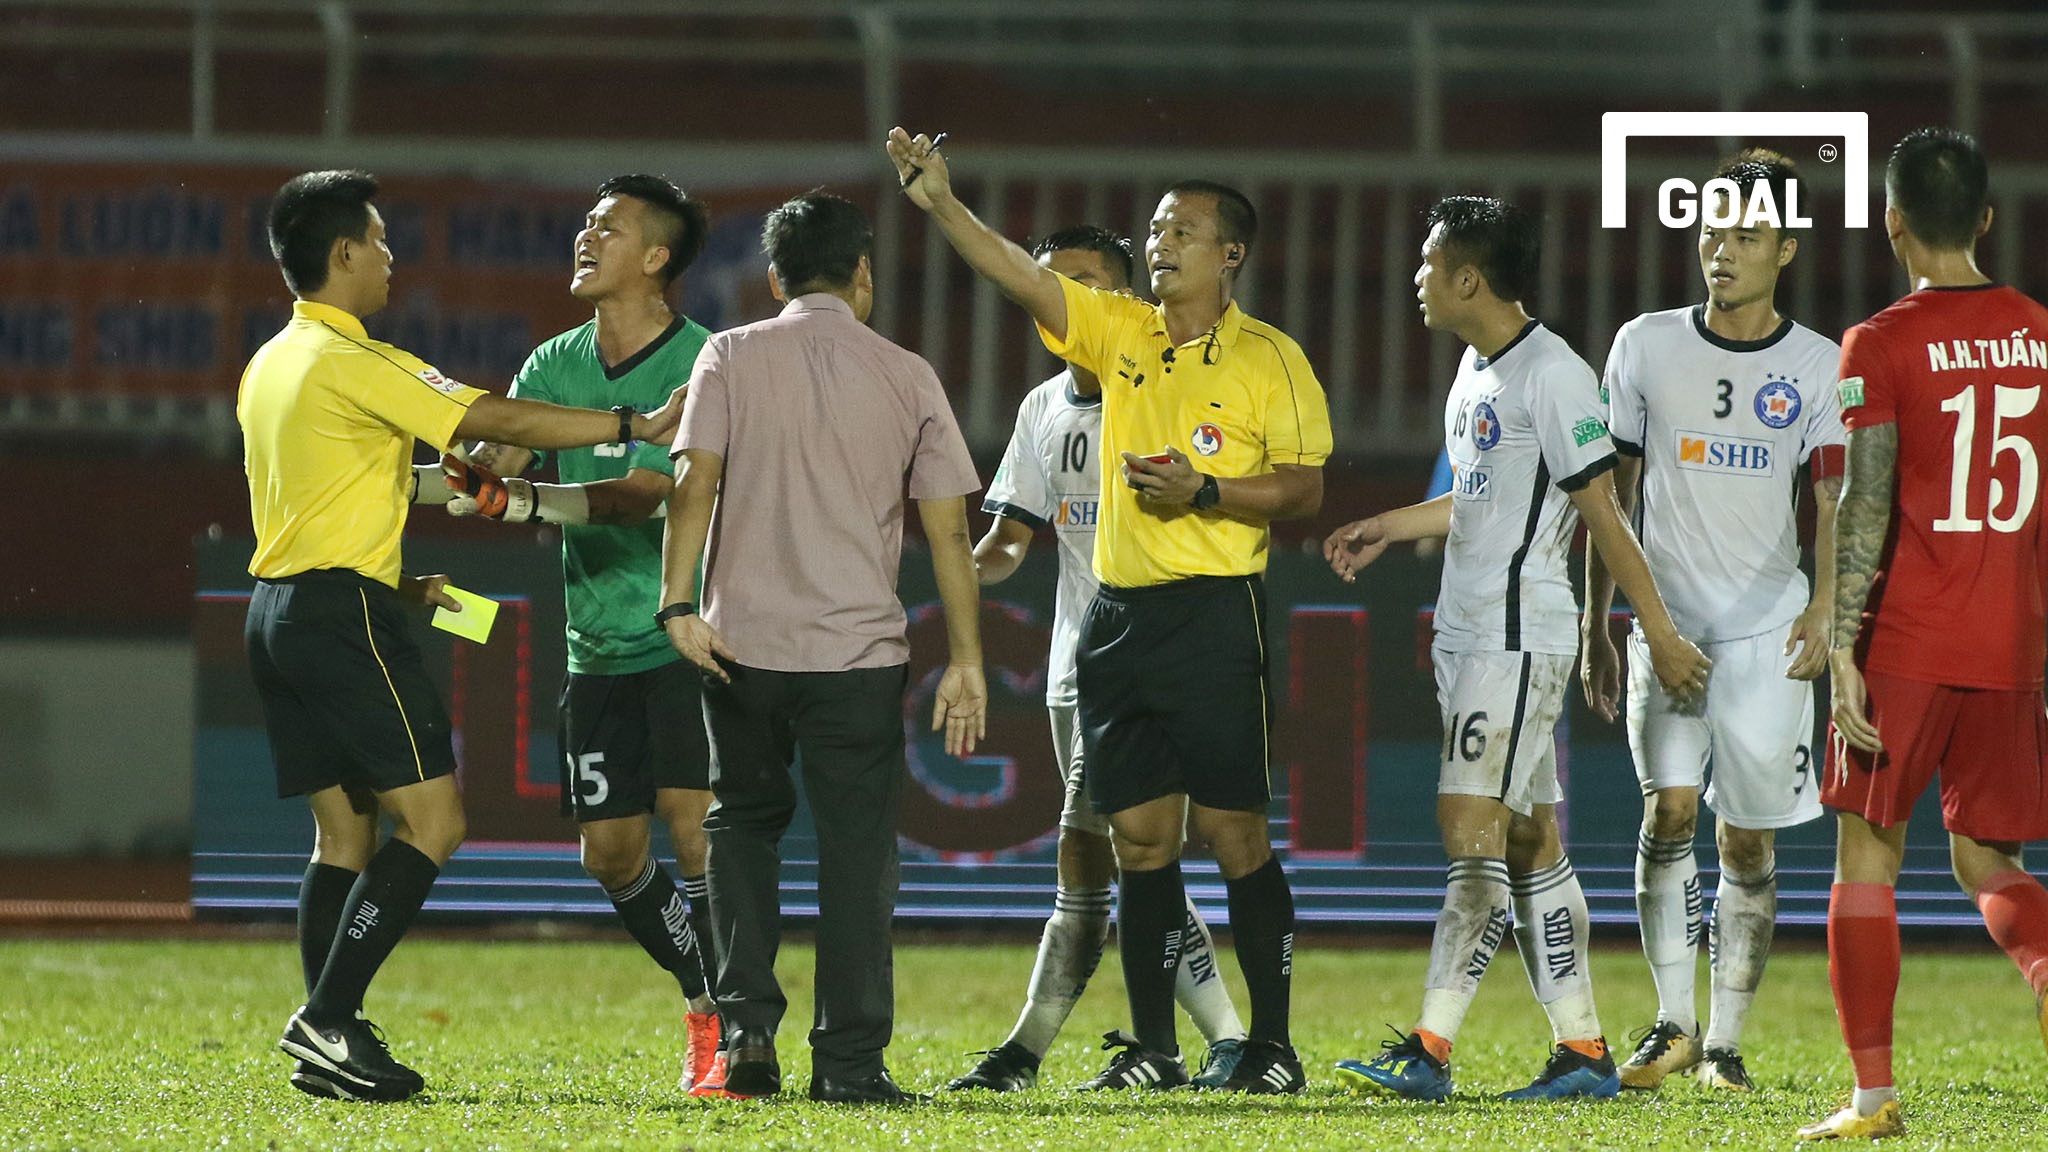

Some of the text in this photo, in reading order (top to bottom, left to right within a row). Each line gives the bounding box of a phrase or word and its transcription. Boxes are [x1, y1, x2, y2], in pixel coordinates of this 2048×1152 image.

[1927, 327, 2048, 373] N.H.TUẤN
[1453, 397, 1471, 439] 16
[1713, 378, 1733, 419] 3
[1061, 431, 1088, 473] 10
[1708, 441, 1769, 470] SHB
[1933, 383, 2042, 533] 15
[1456, 467, 1489, 495] SHB
[1068, 501, 1098, 526] SH
[1447, 710, 1489, 762] 16
[1793, 744, 1810, 795] 3
[347, 900, 379, 939] mitre
[1481, 905, 1507, 951] SHB
[1163, 929, 1183, 969] mitre
[1281, 932, 1294, 976] mitre
[1543, 906, 1578, 980] SHB DN
